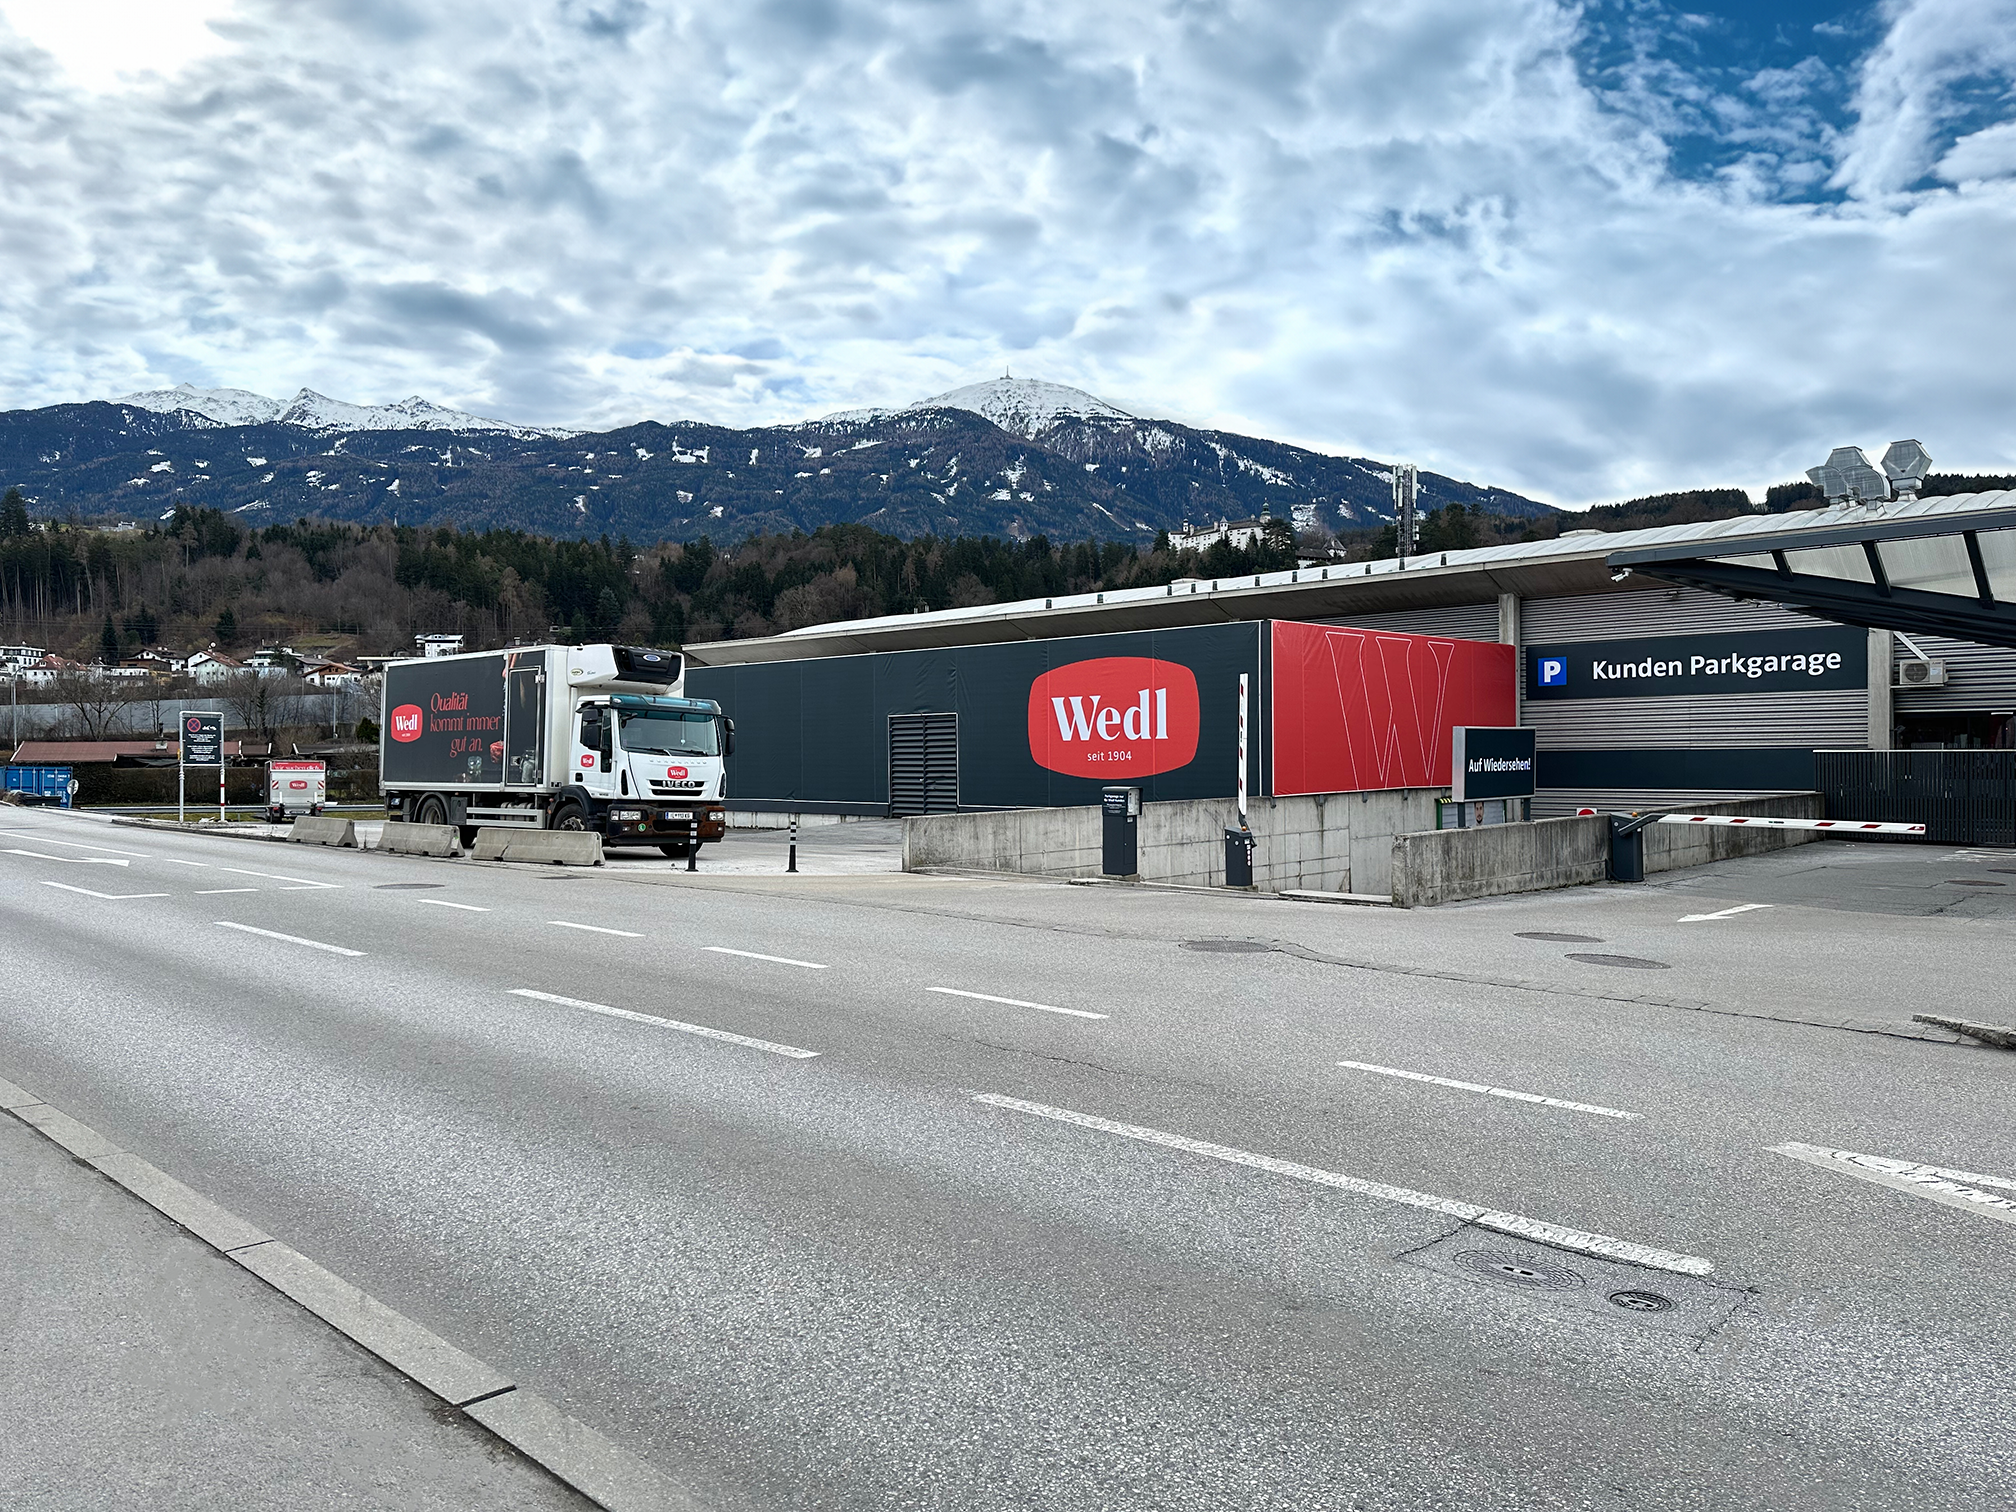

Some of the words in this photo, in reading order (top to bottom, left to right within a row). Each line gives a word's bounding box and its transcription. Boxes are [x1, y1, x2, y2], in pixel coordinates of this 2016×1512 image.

[1543, 661, 1562, 683] P
[1592, 658, 1683, 680] Kunden
[1690, 652, 1842, 678] Parkgarage
[430, 691, 469, 714] Qualität
[395, 714, 418, 731] Wedl
[430, 713, 464, 732] kommt
[466, 712, 502, 731] immer
[1050, 687, 1169, 742] Wedl
[449, 735, 467, 758] gut
[468, 737, 483, 752] an.
[1087, 751, 1105, 761] seit
[1107, 750, 1132, 761] 1904
[1468, 758, 1482, 773] Auf
[1483, 757, 1531, 772] Wiedersehen!
[662, 780, 696, 788] IVECO
